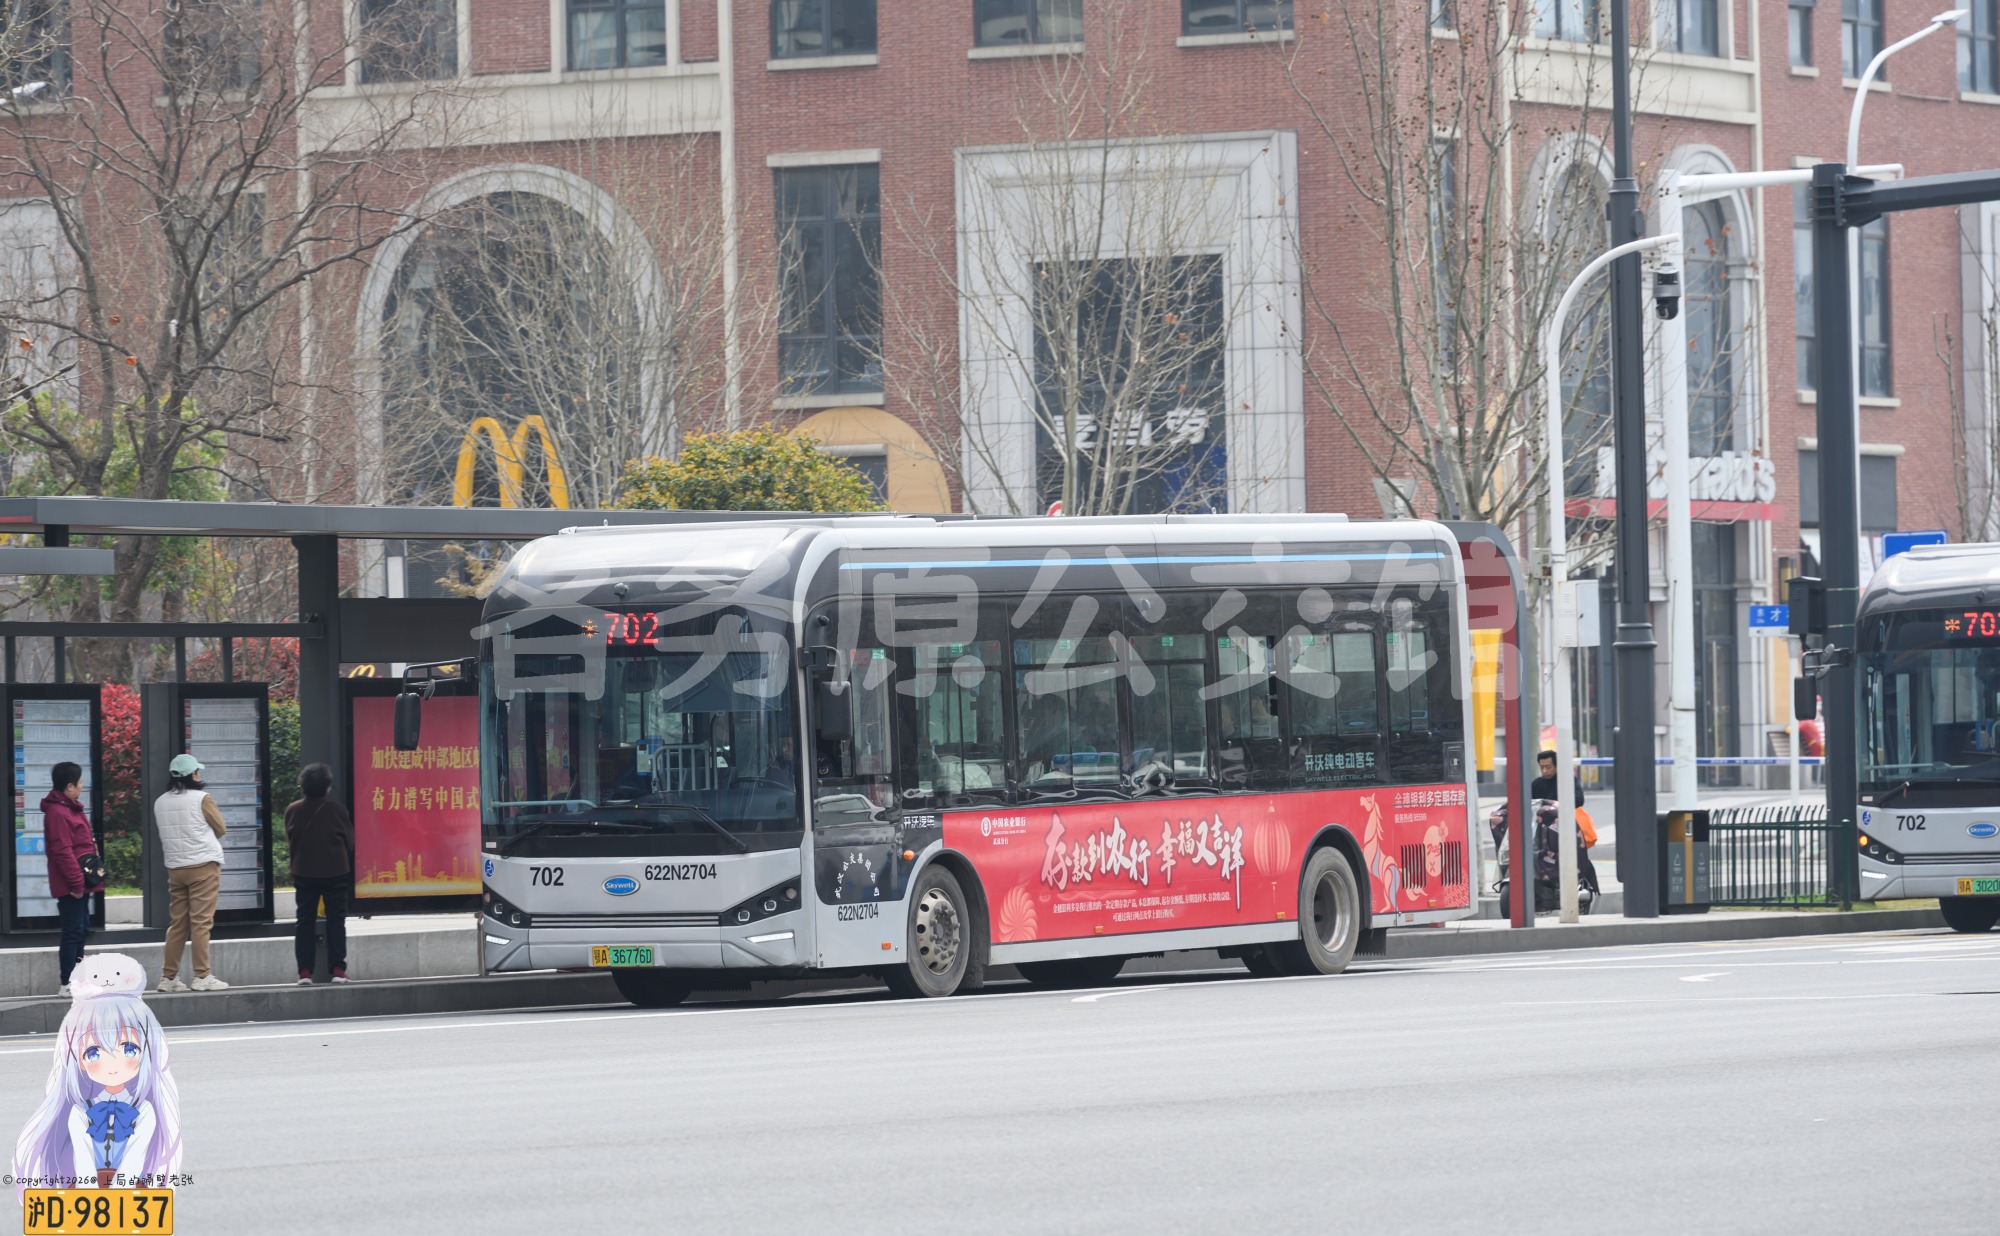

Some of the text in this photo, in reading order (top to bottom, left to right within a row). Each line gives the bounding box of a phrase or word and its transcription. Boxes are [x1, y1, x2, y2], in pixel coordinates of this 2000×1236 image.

[604, 612, 659, 645] 702
[1963, 611, 2000, 637] 70
[1304, 752, 1375, 771] 开沃纯电动客车
[1896, 814, 1926, 831] 702
[529, 866, 564, 887] 702
[644, 863, 718, 881] 622N2704
[605, 881, 636, 891] Skywell
[837, 903, 879, 921] 622N2704
